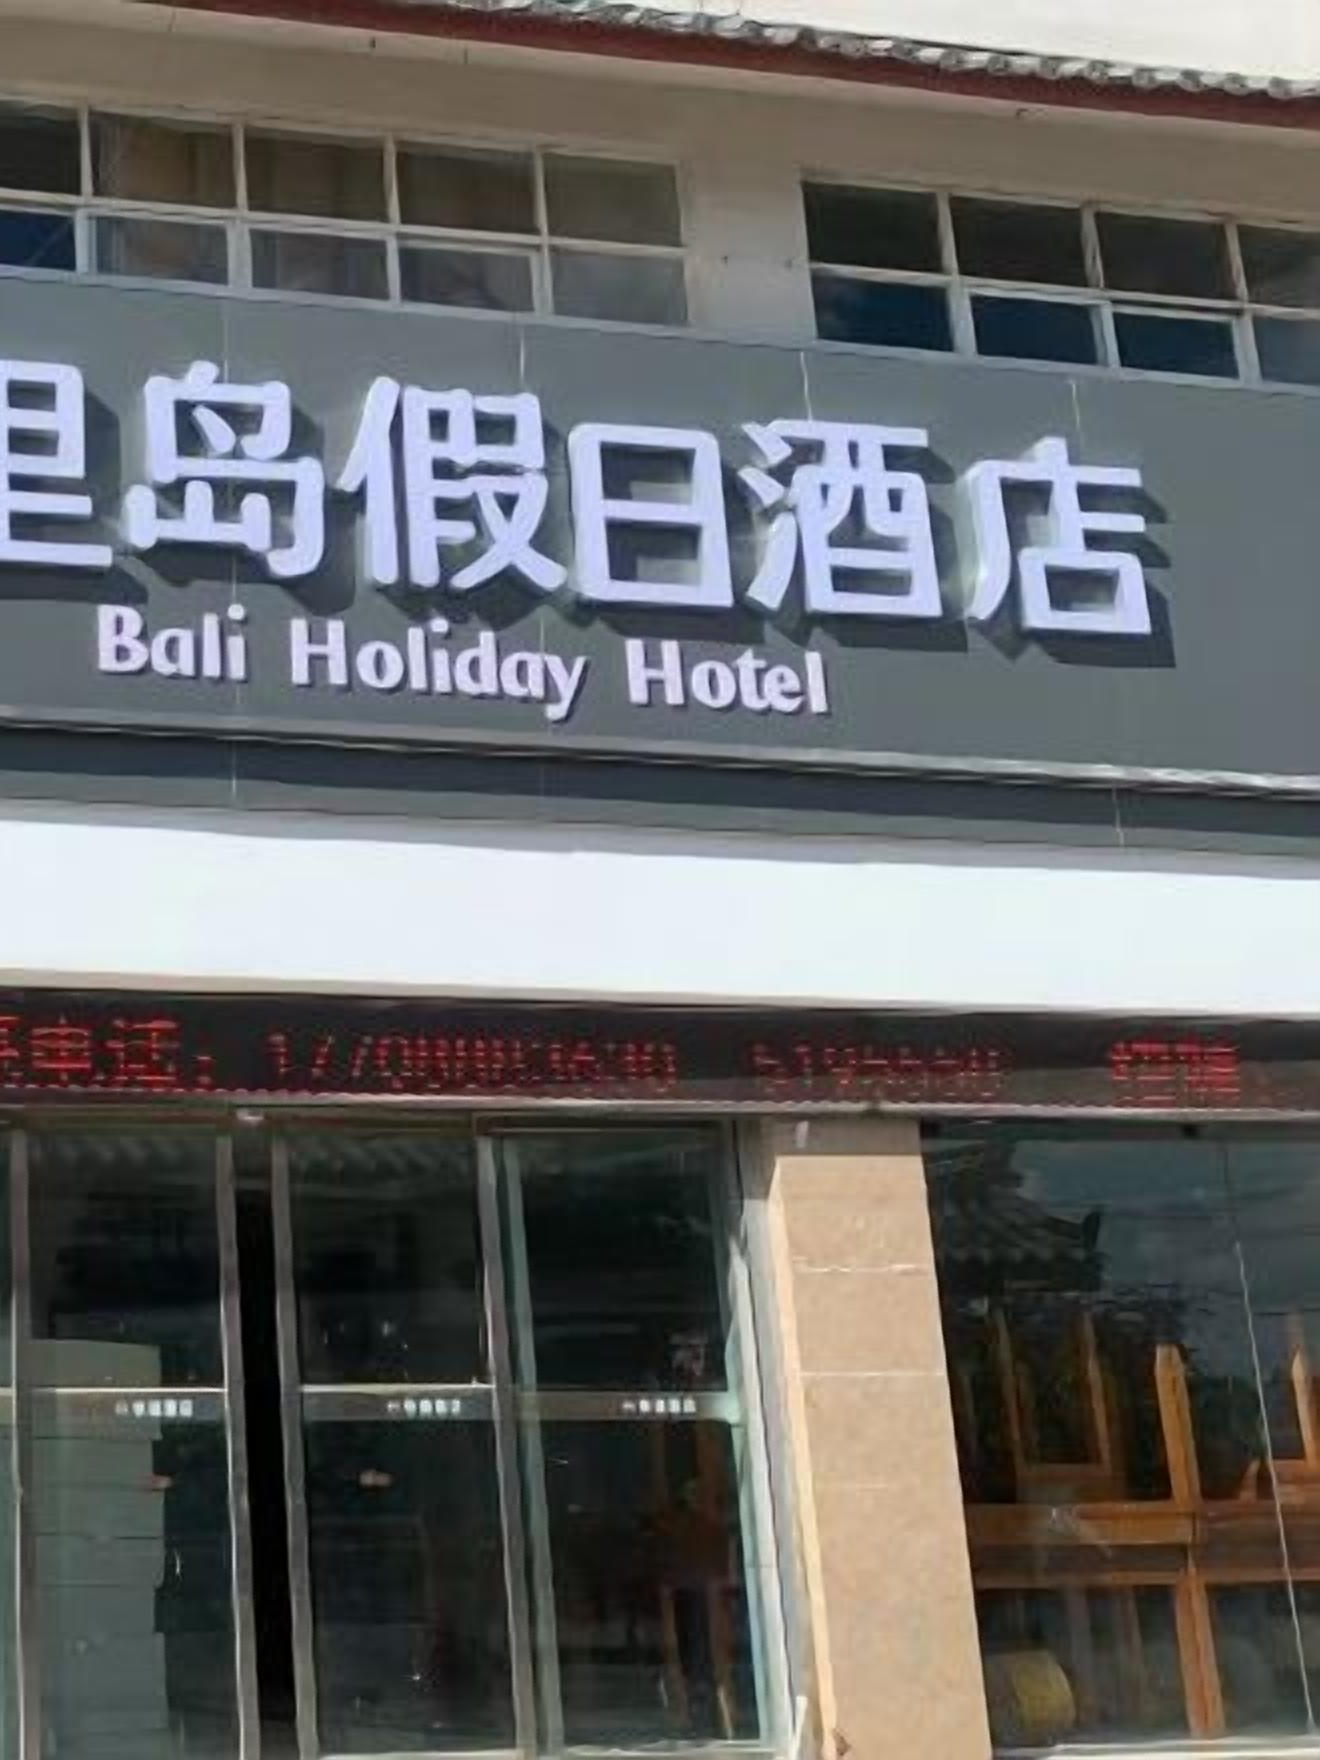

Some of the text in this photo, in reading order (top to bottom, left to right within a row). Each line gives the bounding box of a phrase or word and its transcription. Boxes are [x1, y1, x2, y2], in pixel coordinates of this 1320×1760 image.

[96, 603, 828, 720] Bali Holiday Hotel
